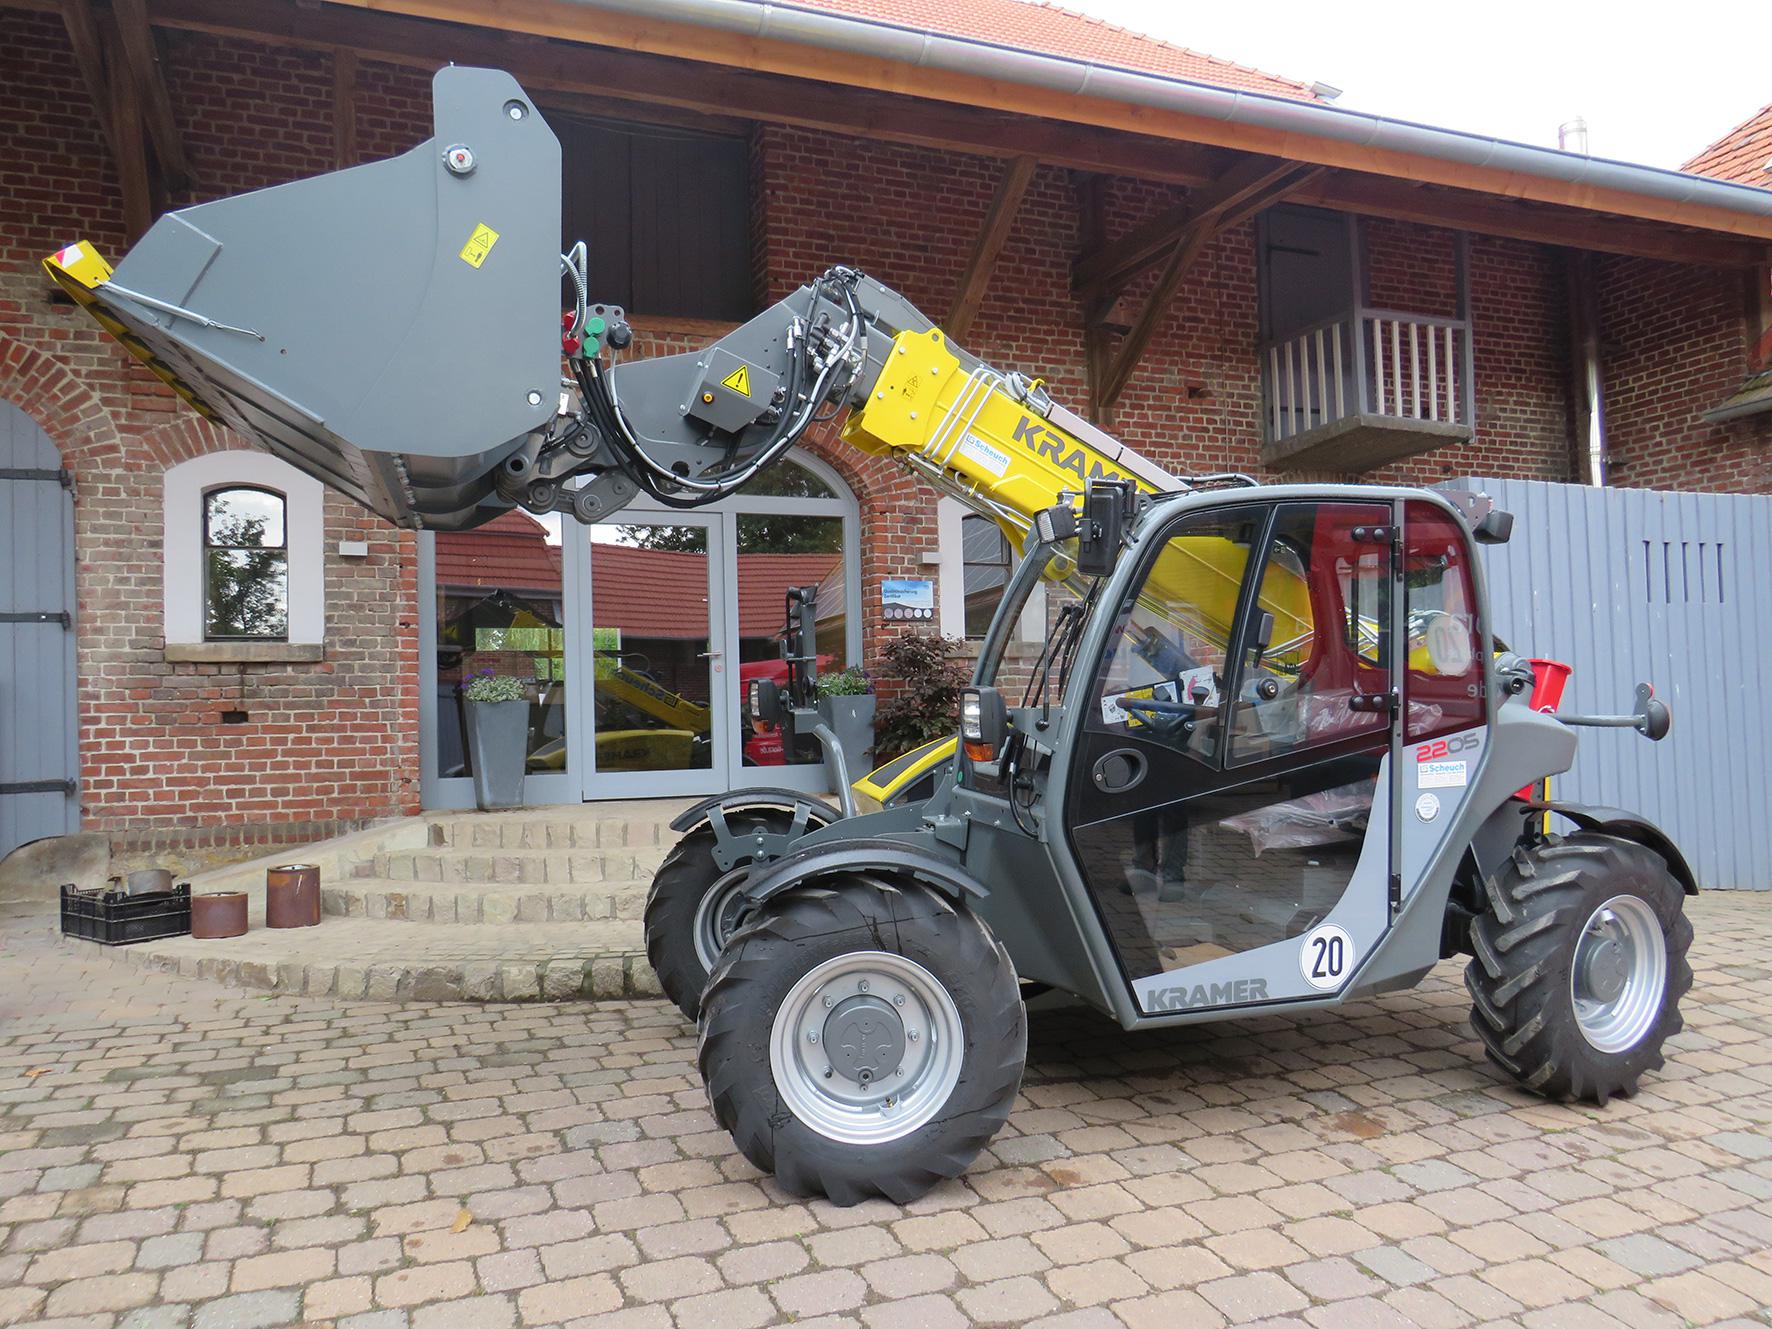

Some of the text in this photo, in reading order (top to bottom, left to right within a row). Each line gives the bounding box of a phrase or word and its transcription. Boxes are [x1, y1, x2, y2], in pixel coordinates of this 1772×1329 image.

[975, 440, 1008, 465] Scheuch
[1416, 732, 1480, 763] 2205
[1429, 763, 1465, 773] Scheuch
[1311, 935, 1344, 978] 20
[1146, 978, 1270, 1012] KRAMER
